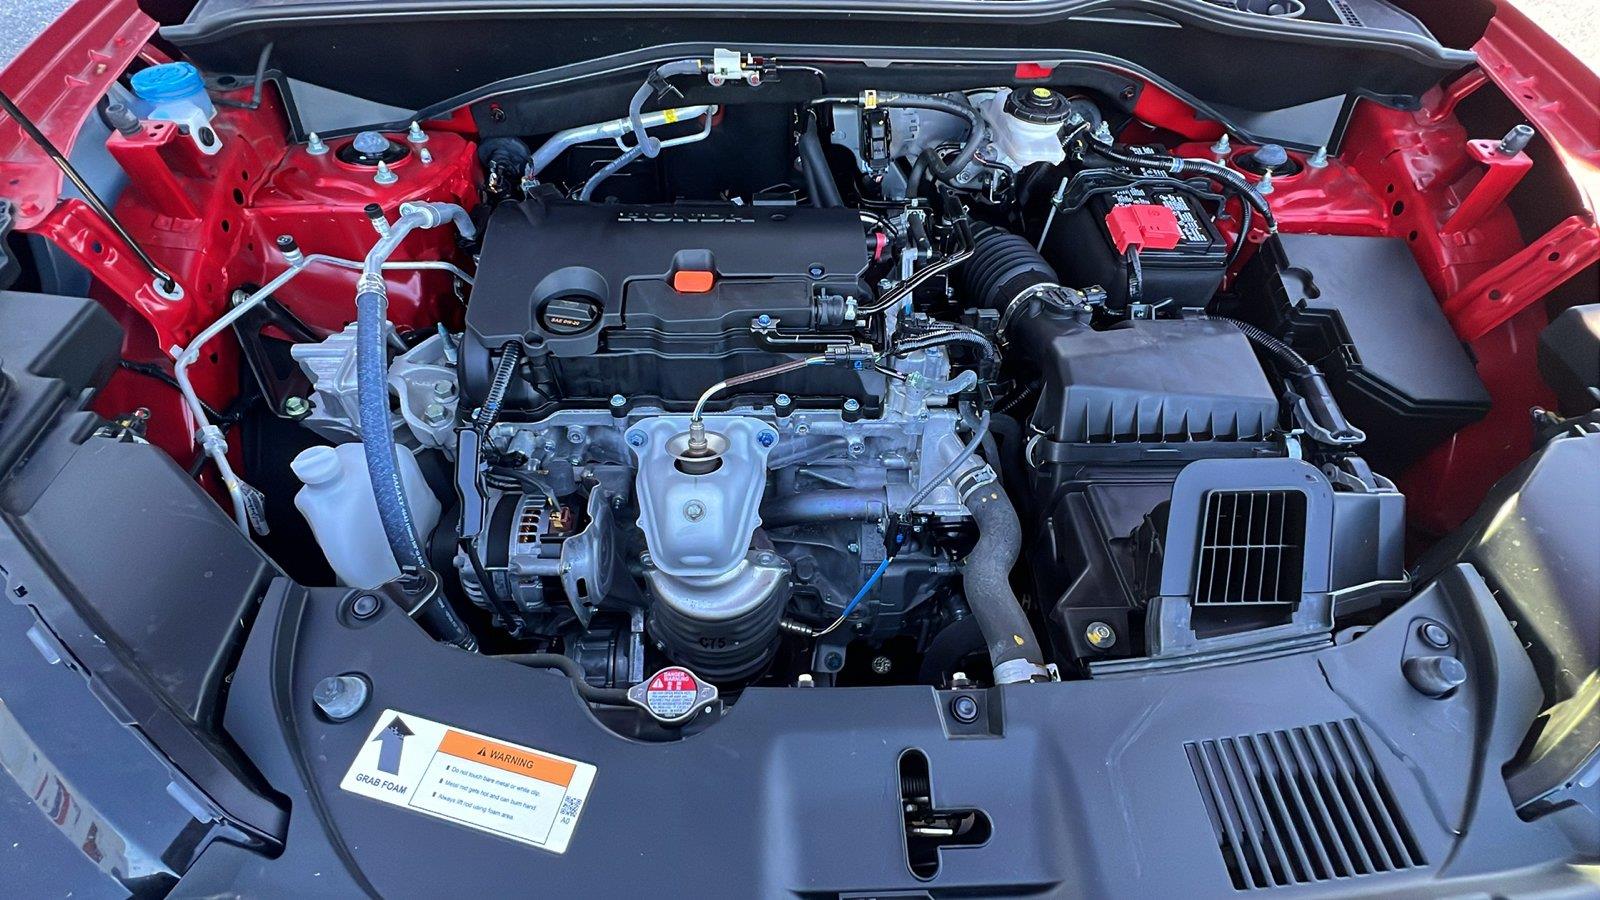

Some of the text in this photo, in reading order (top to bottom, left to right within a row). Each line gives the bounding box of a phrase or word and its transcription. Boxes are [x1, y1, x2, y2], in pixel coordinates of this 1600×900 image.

[490, 750, 534, 769] WARNING
[356, 773, 408, 795] GRAB FOAM
[495, 780, 511, 788] metal
[438, 793, 456, 803] Always
[473, 804, 487, 813] using
[488, 807, 501, 816] foam
[445, 780, 460, 788] Metal
[523, 802, 537, 811] hand
